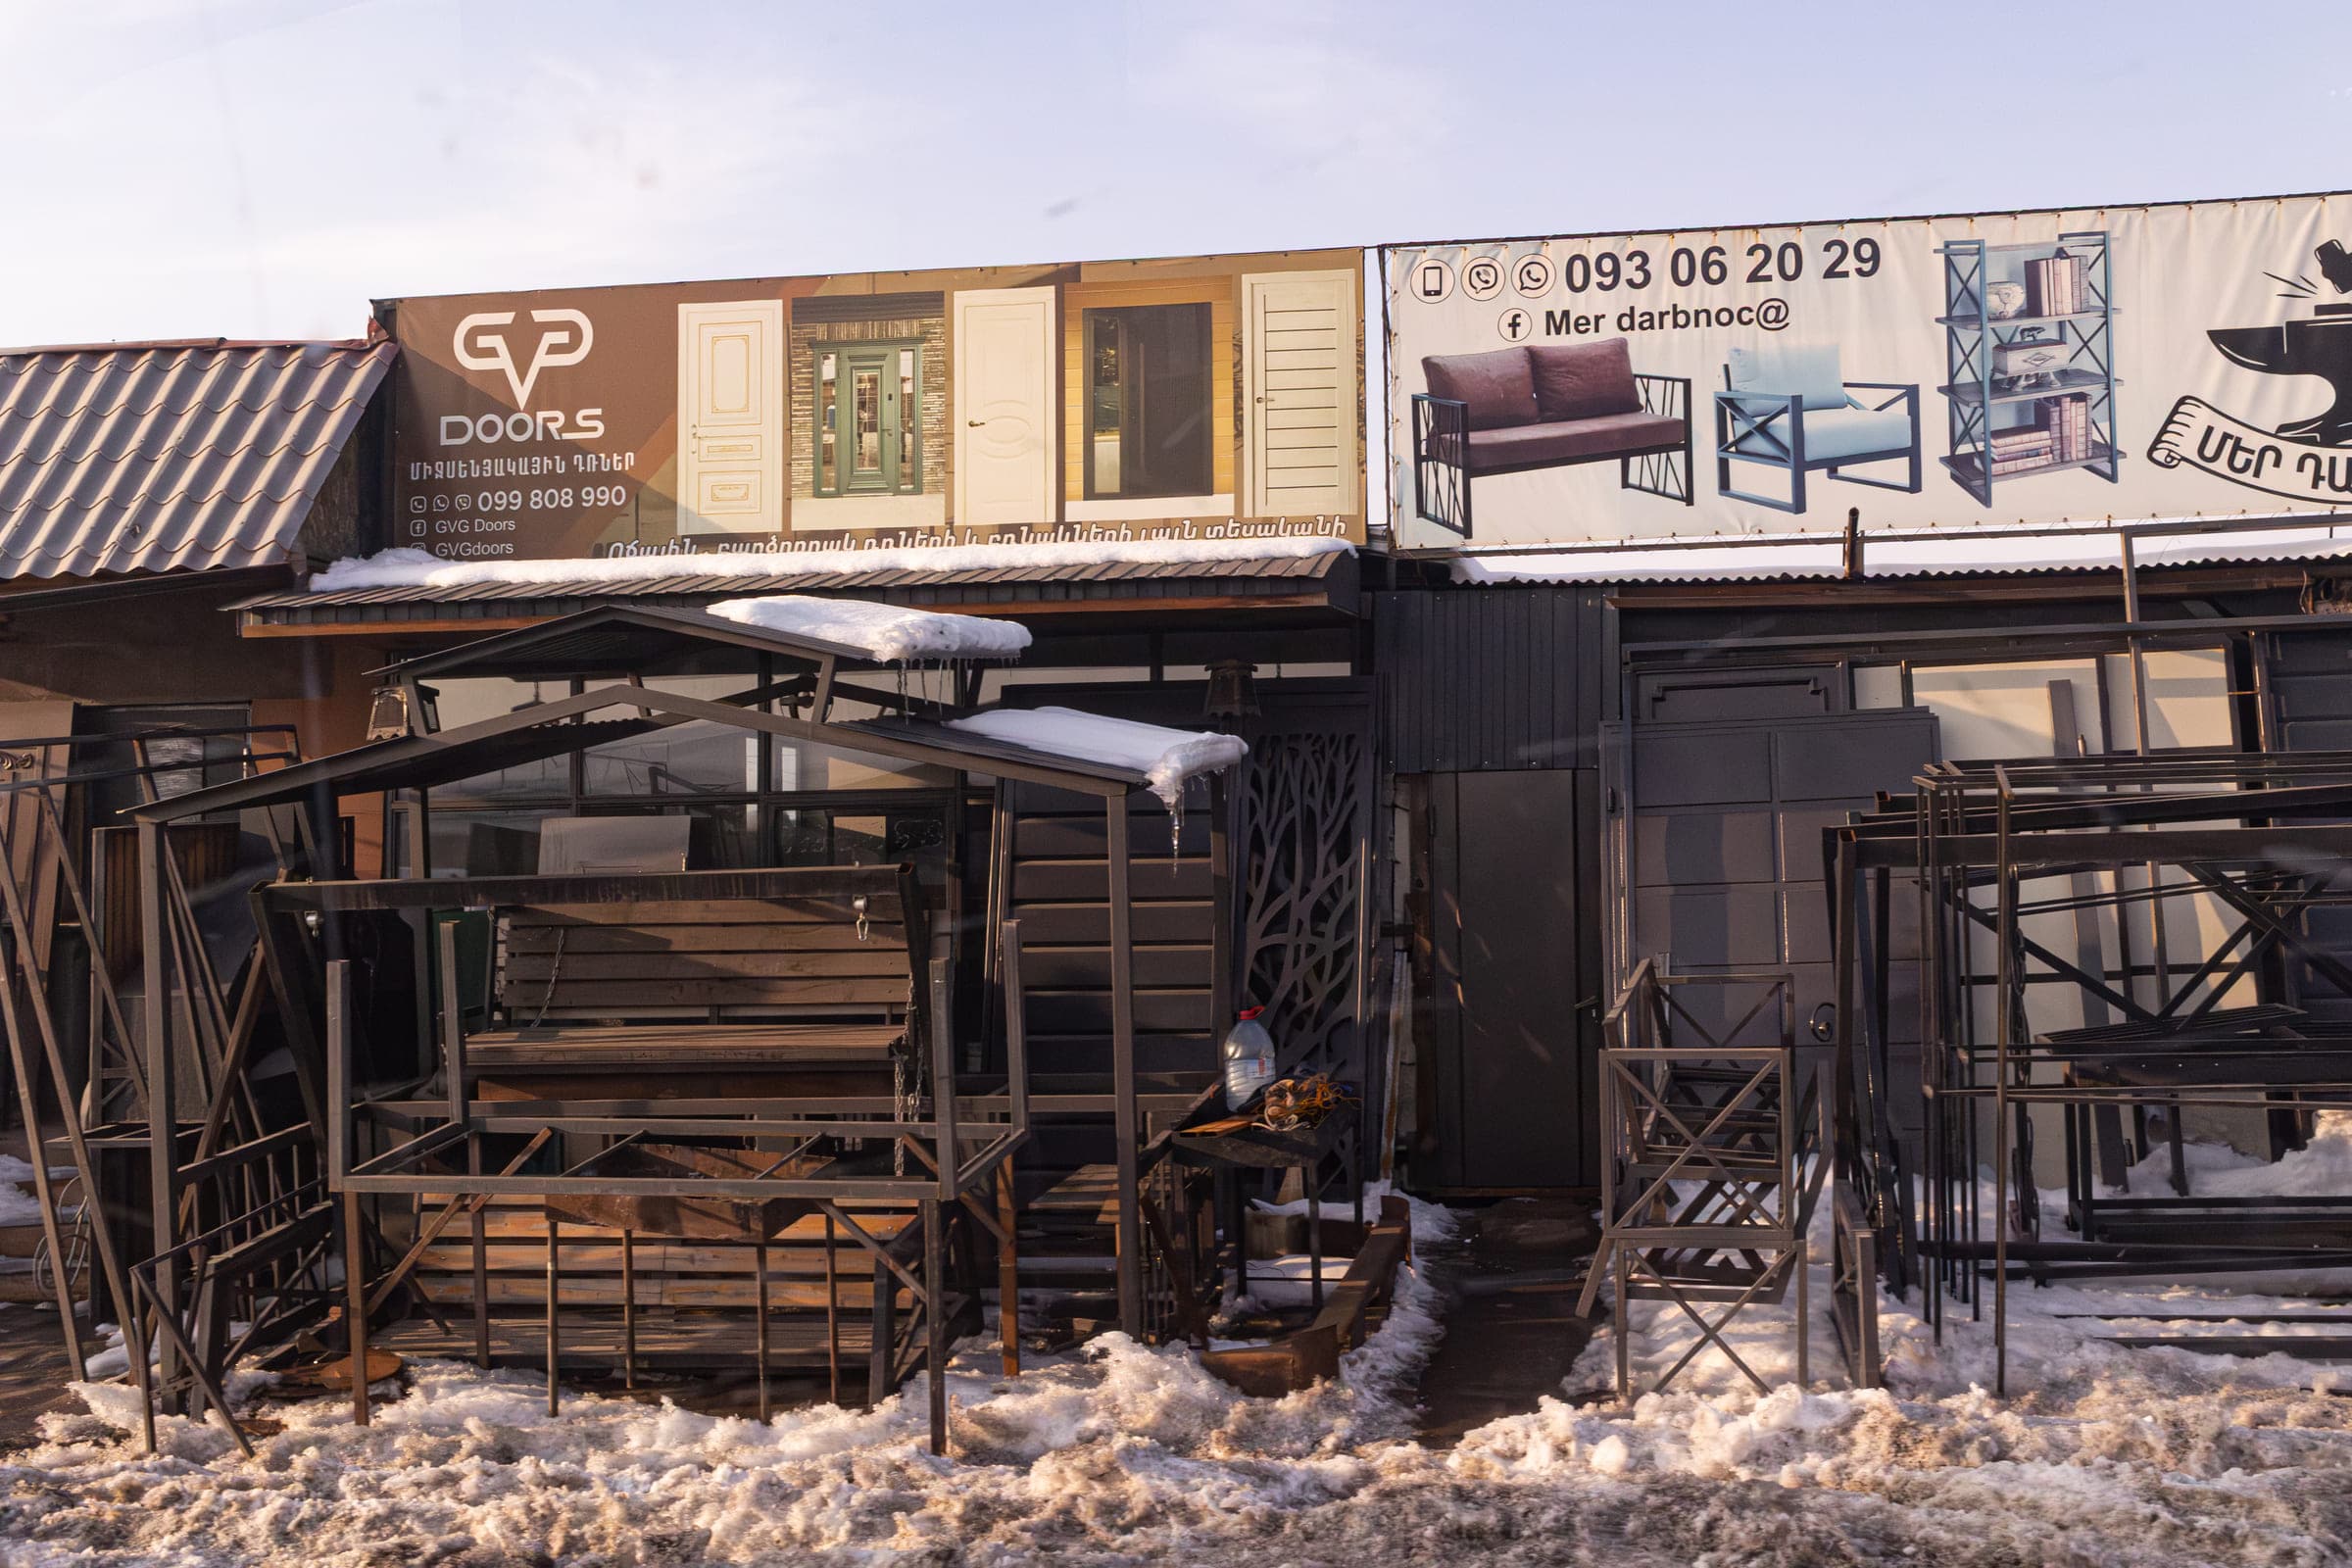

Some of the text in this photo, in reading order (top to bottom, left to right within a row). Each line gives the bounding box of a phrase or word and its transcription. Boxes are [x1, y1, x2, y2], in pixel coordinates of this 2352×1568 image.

[1567, 237, 1882, 294] 093 06 20 29
[1544, 297, 1789, 336] Mer darbnoc@
[440, 408, 605, 446] DOORS
[2197, 424, 2282, 478] ՄԵՐ
[477, 485, 626, 512] 099 808 990
[435, 518, 516, 534] GVG Doors
[435, 541, 514, 557] GVGdoors
